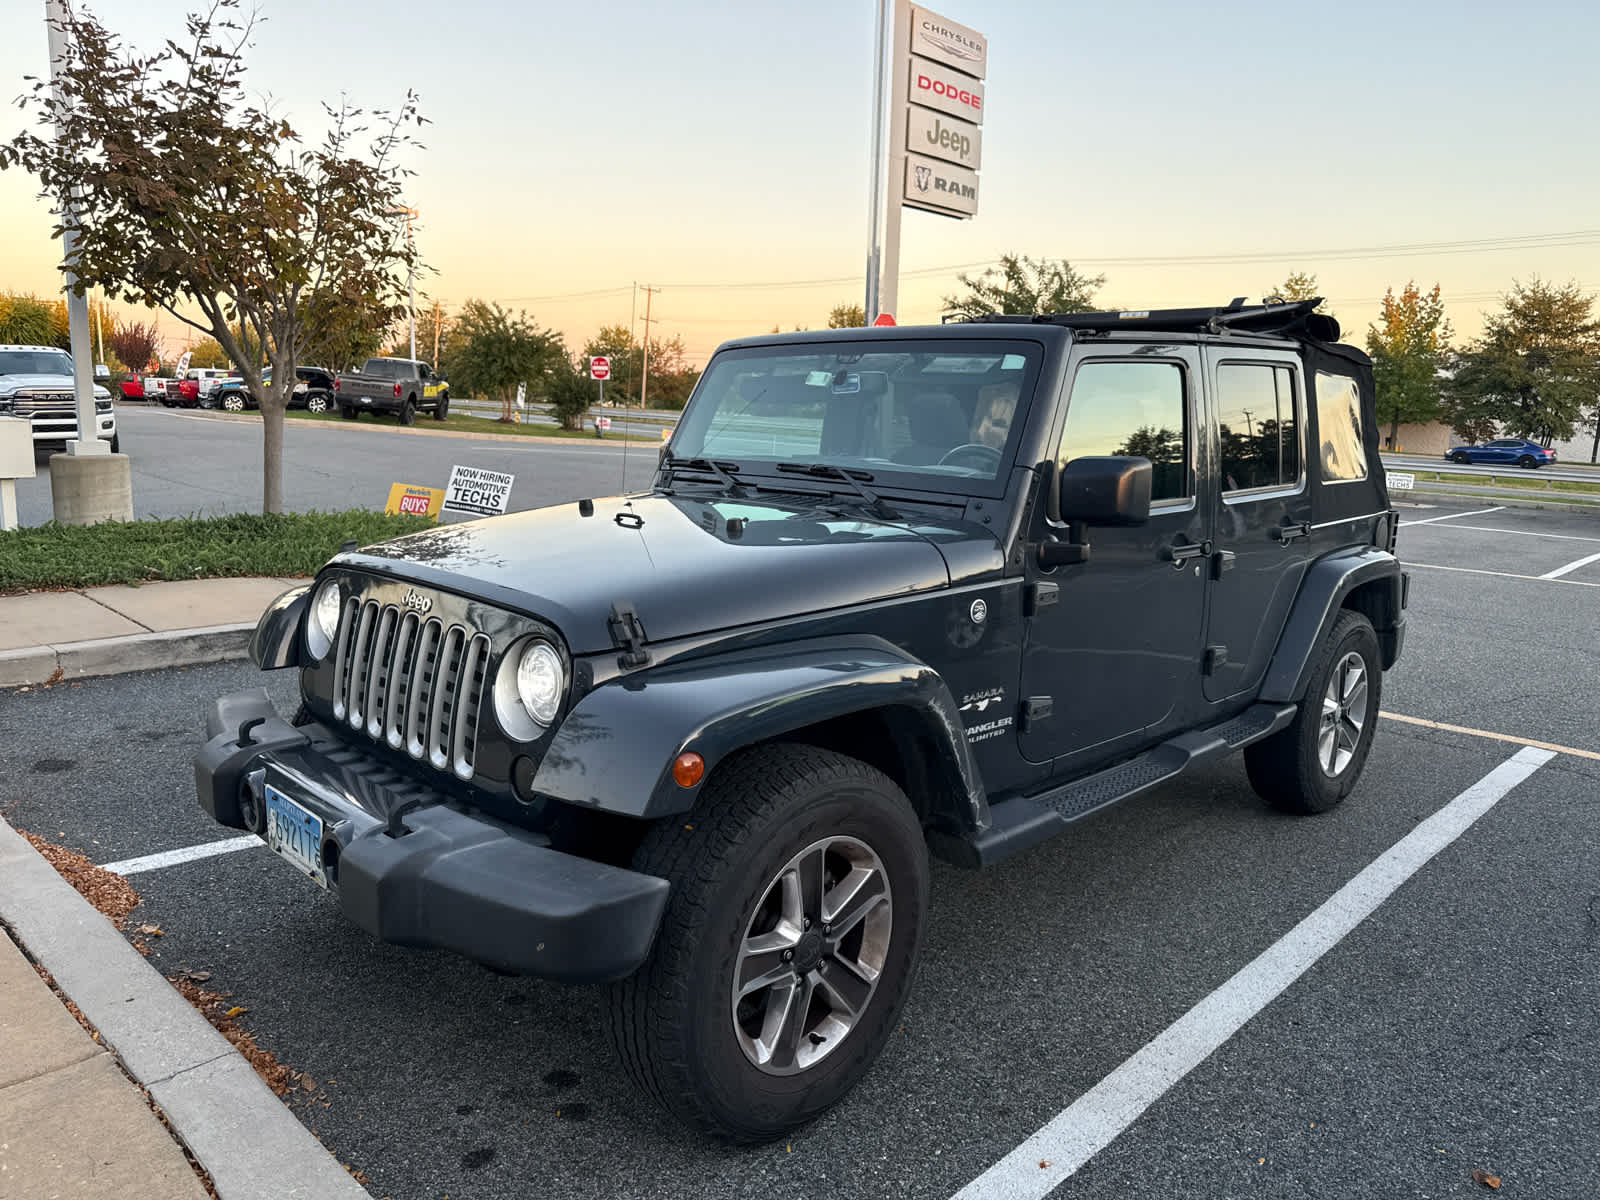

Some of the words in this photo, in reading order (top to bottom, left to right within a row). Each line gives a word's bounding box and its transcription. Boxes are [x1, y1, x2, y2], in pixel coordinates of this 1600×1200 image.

[922, 21, 982, 52] CHRYSLER
[917, 74, 981, 109] DODGE
[927, 119, 970, 159] Jeep
[934, 177, 976, 200] RAM
[451, 478, 508, 495] AUTOMOTIVE
[456, 468, 480, 479] NOW
[480, 470, 511, 485] HIRING
[400, 496, 429, 513] BUYS
[453, 488, 501, 507] TECHS
[401, 587, 432, 615] Jeep
[963, 686, 1005, 704] SAHARA
[965, 716, 1013, 736] ANGLER
